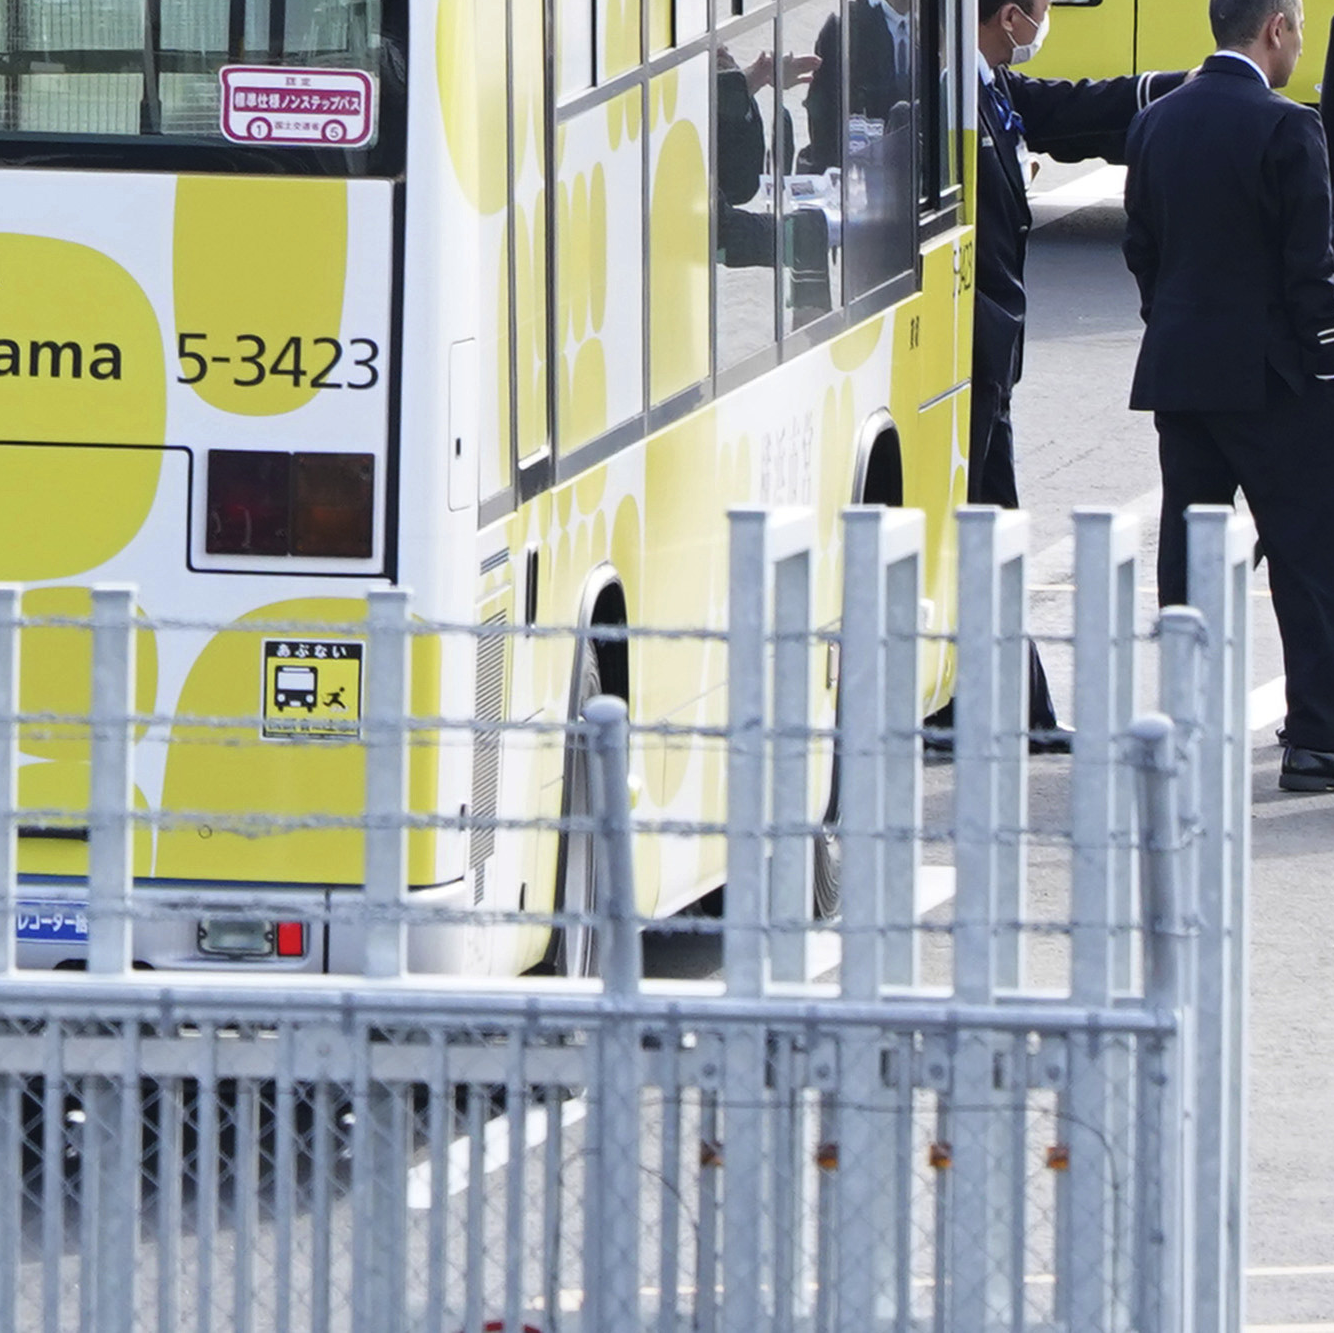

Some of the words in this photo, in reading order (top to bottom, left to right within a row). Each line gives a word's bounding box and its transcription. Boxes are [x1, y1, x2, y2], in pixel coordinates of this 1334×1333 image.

[175, 332, 380, 391] 5-3423
[276, 643, 348, 659] あぶない
